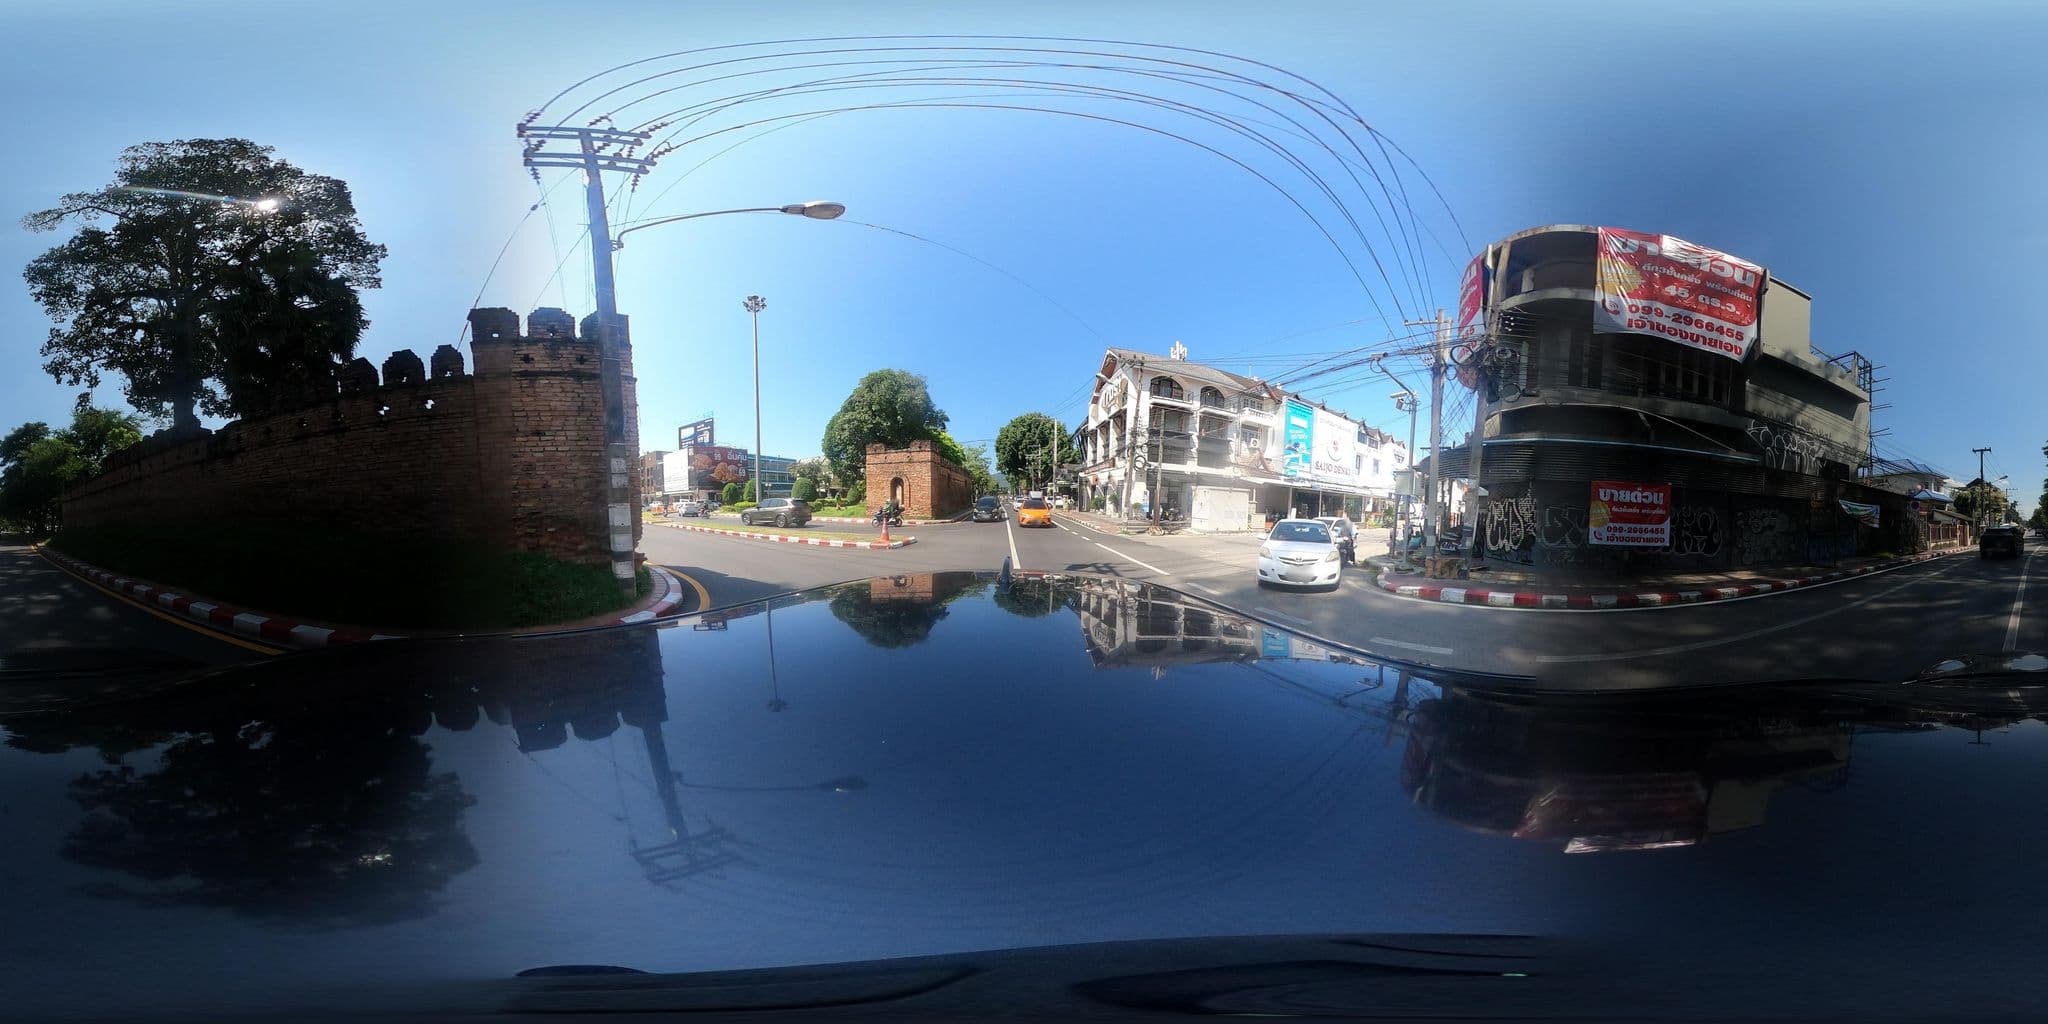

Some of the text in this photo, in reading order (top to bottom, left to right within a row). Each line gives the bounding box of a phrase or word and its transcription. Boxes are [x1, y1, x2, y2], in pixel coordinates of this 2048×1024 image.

[1610, 236, 1755, 288] ขาดวน
[1664, 284, 1689, 299] 45
[1627, 316, 1743, 356] เจ้าของขายเอง
[1628, 303, 1744, 342] 099-2966455
[1315, 461, 1333, 473] SAIJO
[1599, 487, 1664, 505] ขายด่วน
